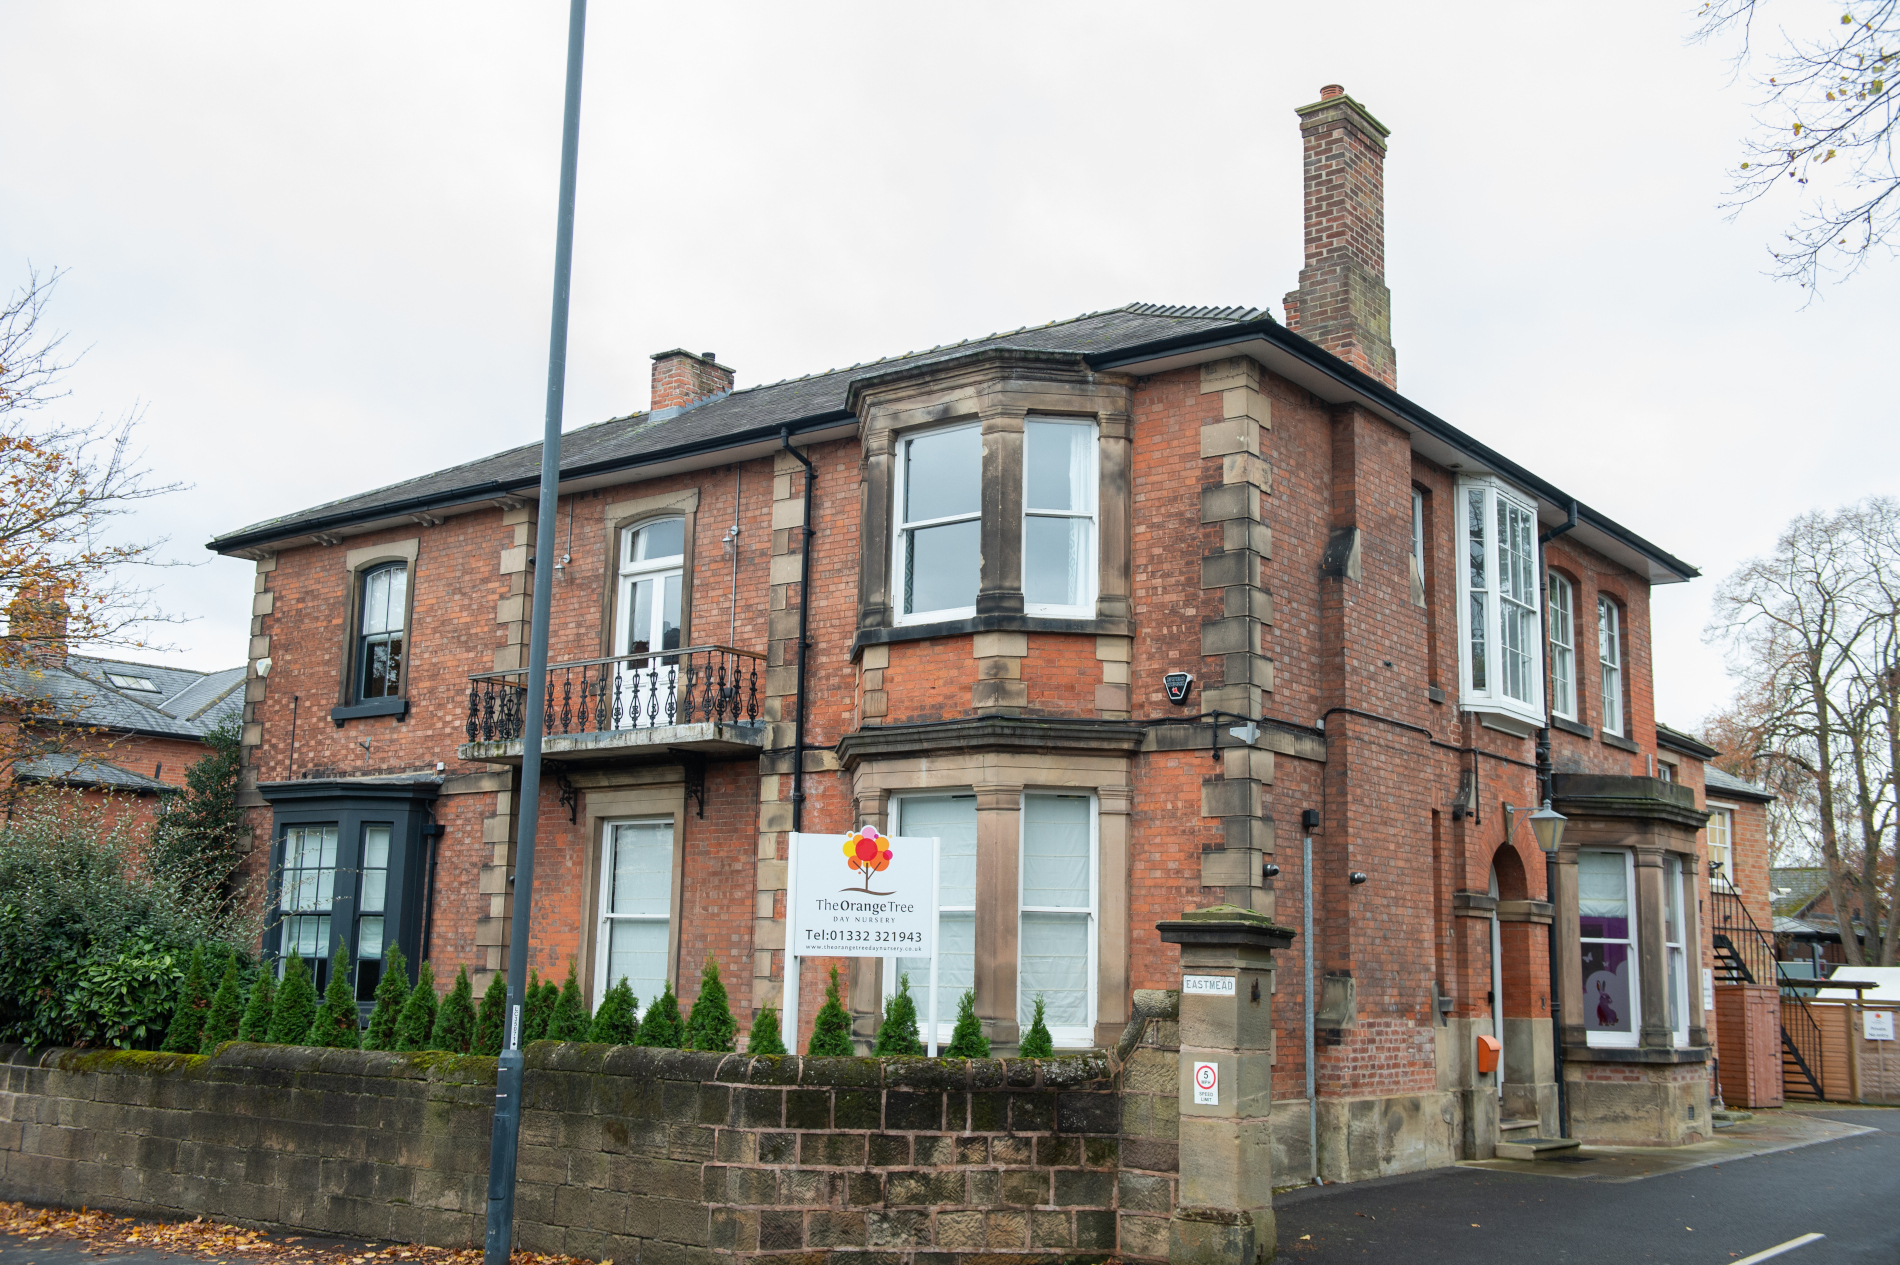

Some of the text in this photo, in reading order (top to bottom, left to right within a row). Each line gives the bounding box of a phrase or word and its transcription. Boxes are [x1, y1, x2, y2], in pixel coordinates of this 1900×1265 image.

[874, 931, 922, 942] 321943
[805, 944, 922, 953] www.theorangetreedaynursery.co.uk
[1186, 979, 1233, 990] EASTMEAD
[1203, 1070, 1209, 1079] 5
